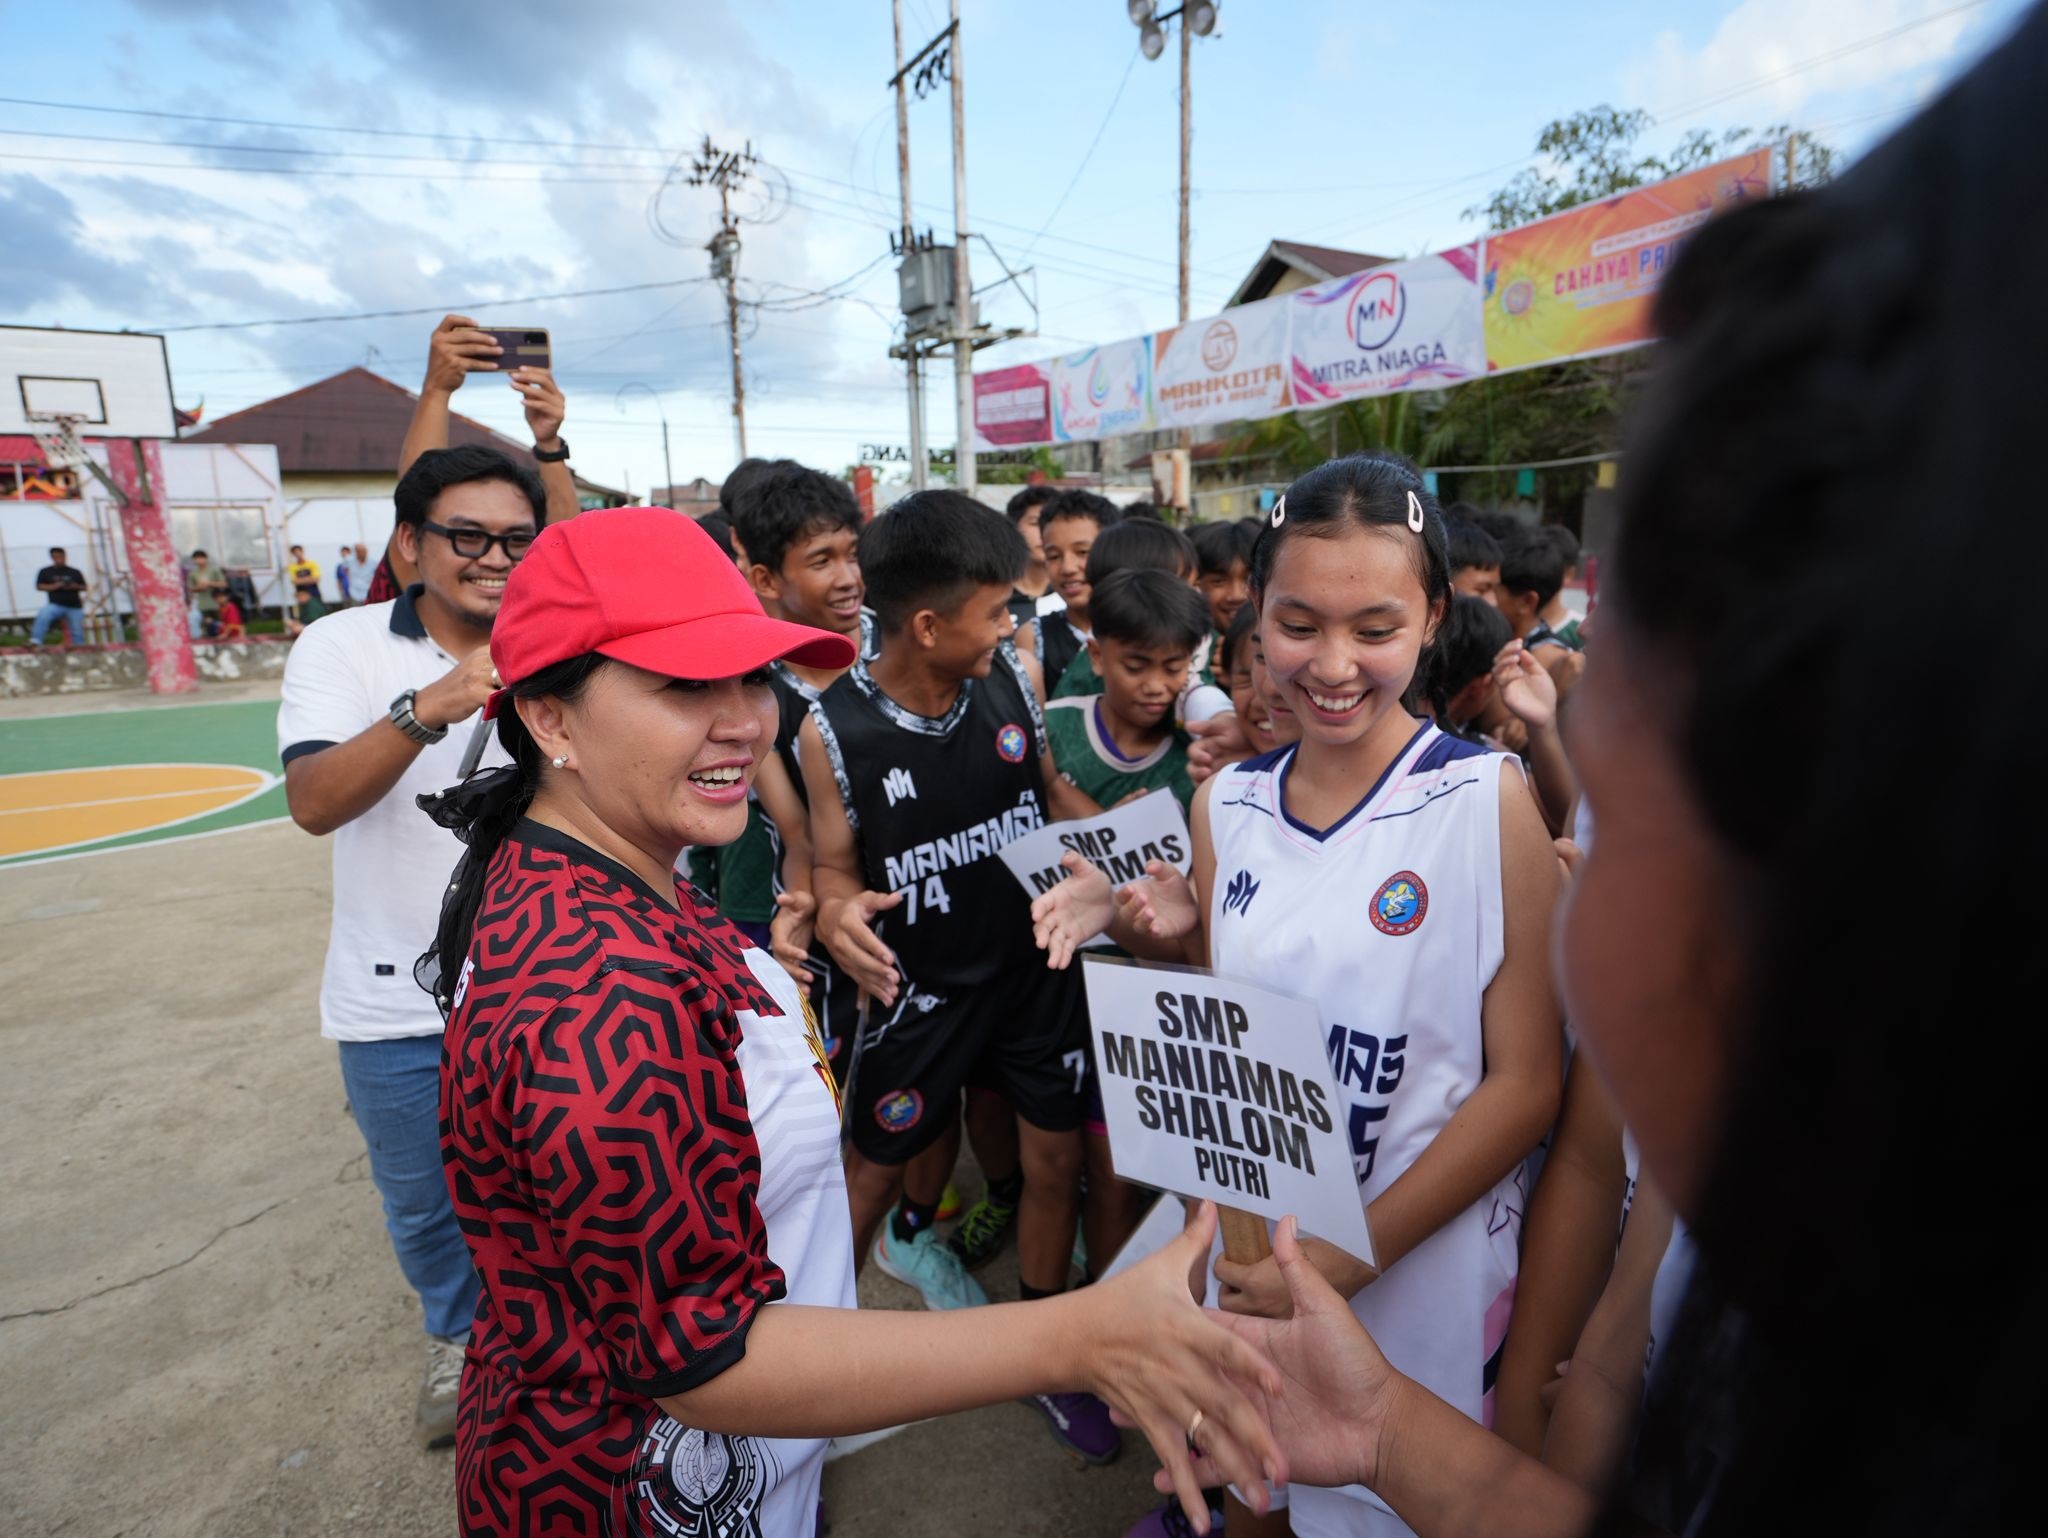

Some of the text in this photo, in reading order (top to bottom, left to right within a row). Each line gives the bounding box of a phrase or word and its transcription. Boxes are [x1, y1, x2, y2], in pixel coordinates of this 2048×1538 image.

[1554, 255, 1630, 295] CAHAYA
[1160, 363, 1281, 402] MAHKOTA
[1312, 357, 1372, 383] MITRA
[1377, 341, 1447, 373] NIAGA
[1060, 826, 1117, 859] SMP
[900, 875, 951, 926] 74
[1155, 991, 1249, 1050] SMP
[1101, 1030, 1333, 1135] MANIAMAS
[1135, 1084, 1317, 1177] SHALOM
[1194, 1146, 1271, 1200] PUTRI
